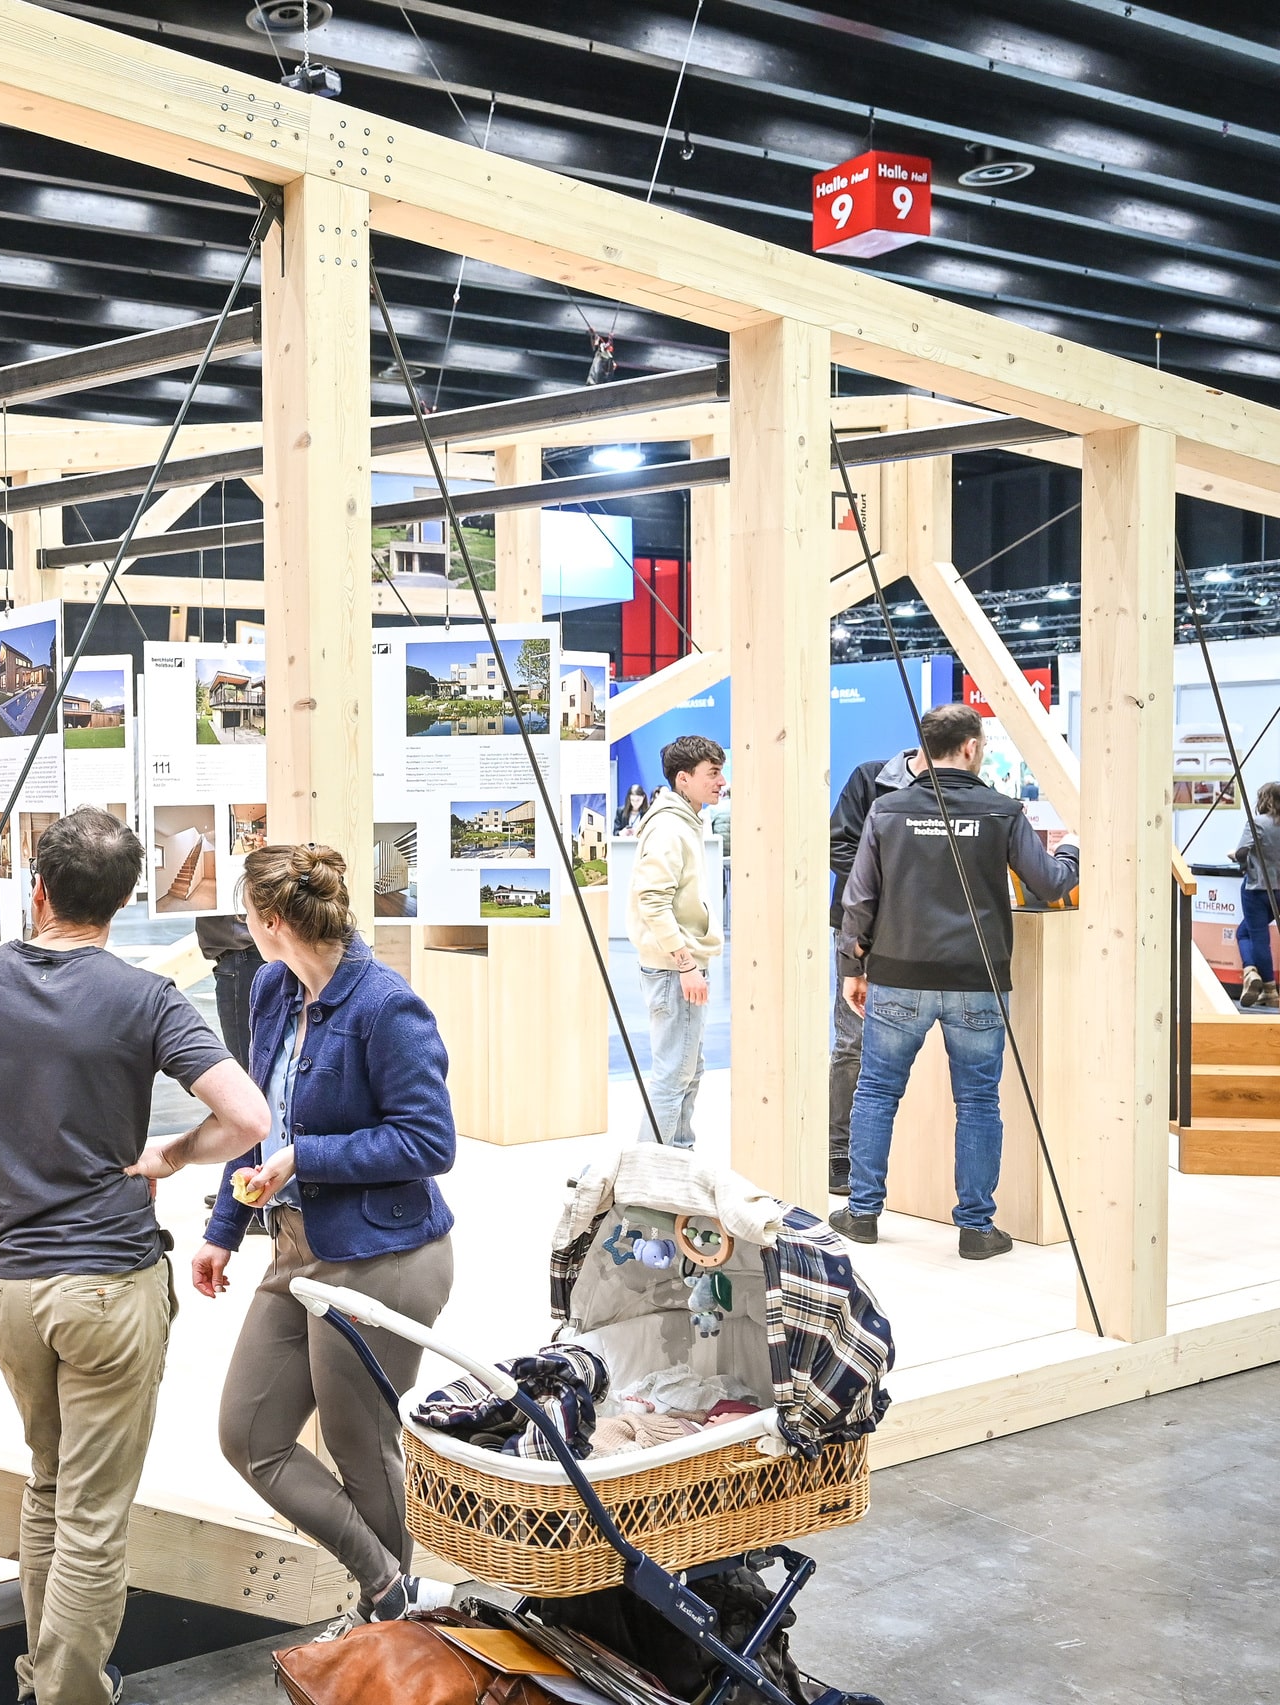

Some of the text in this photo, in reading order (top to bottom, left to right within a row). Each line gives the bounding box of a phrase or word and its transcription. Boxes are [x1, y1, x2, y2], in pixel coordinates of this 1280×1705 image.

[816, 168, 869, 198] Halle Hall
[878, 163, 927, 182] Halle Hall
[831, 194, 853, 229] 9
[892, 186, 913, 220] 9
[153, 762, 170, 773] 111
[906, 818, 954, 827] berchtod
